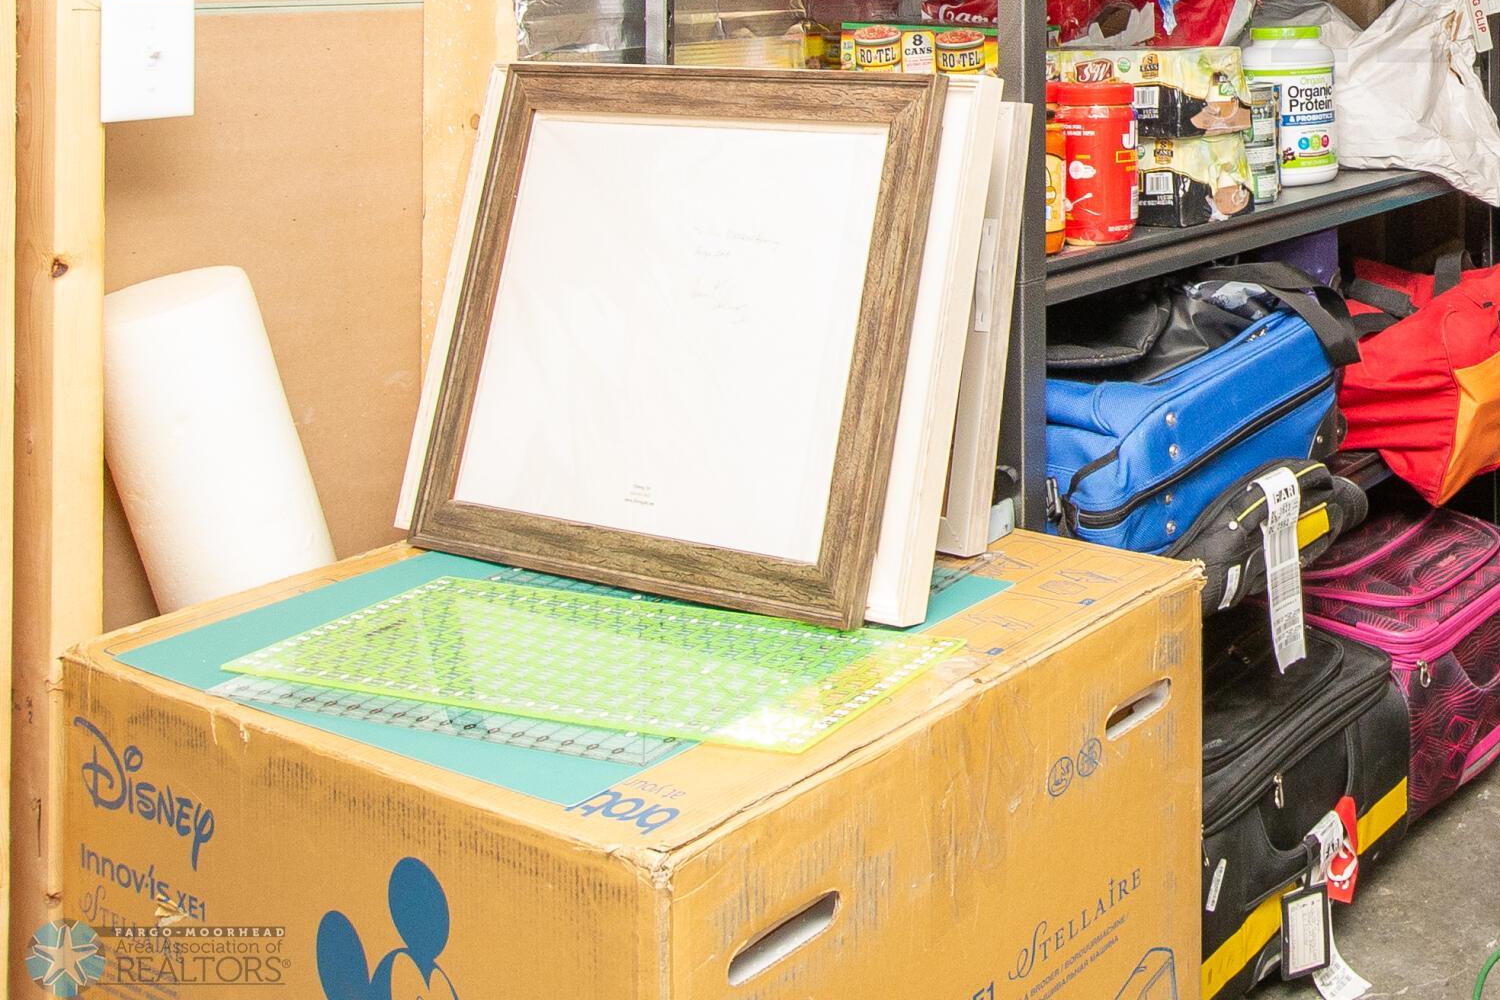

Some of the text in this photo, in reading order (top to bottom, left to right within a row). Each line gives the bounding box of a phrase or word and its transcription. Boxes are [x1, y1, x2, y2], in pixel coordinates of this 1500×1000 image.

[1475, 9, 1487, 33] CLIP
[912, 33, 923, 46] 8
[904, 46, 933, 56] CANS
[1287, 84, 1333, 101] Organic
[1289, 98, 1333, 113] Protein
[1296, 113, 1333, 122] PROBIOTICS
